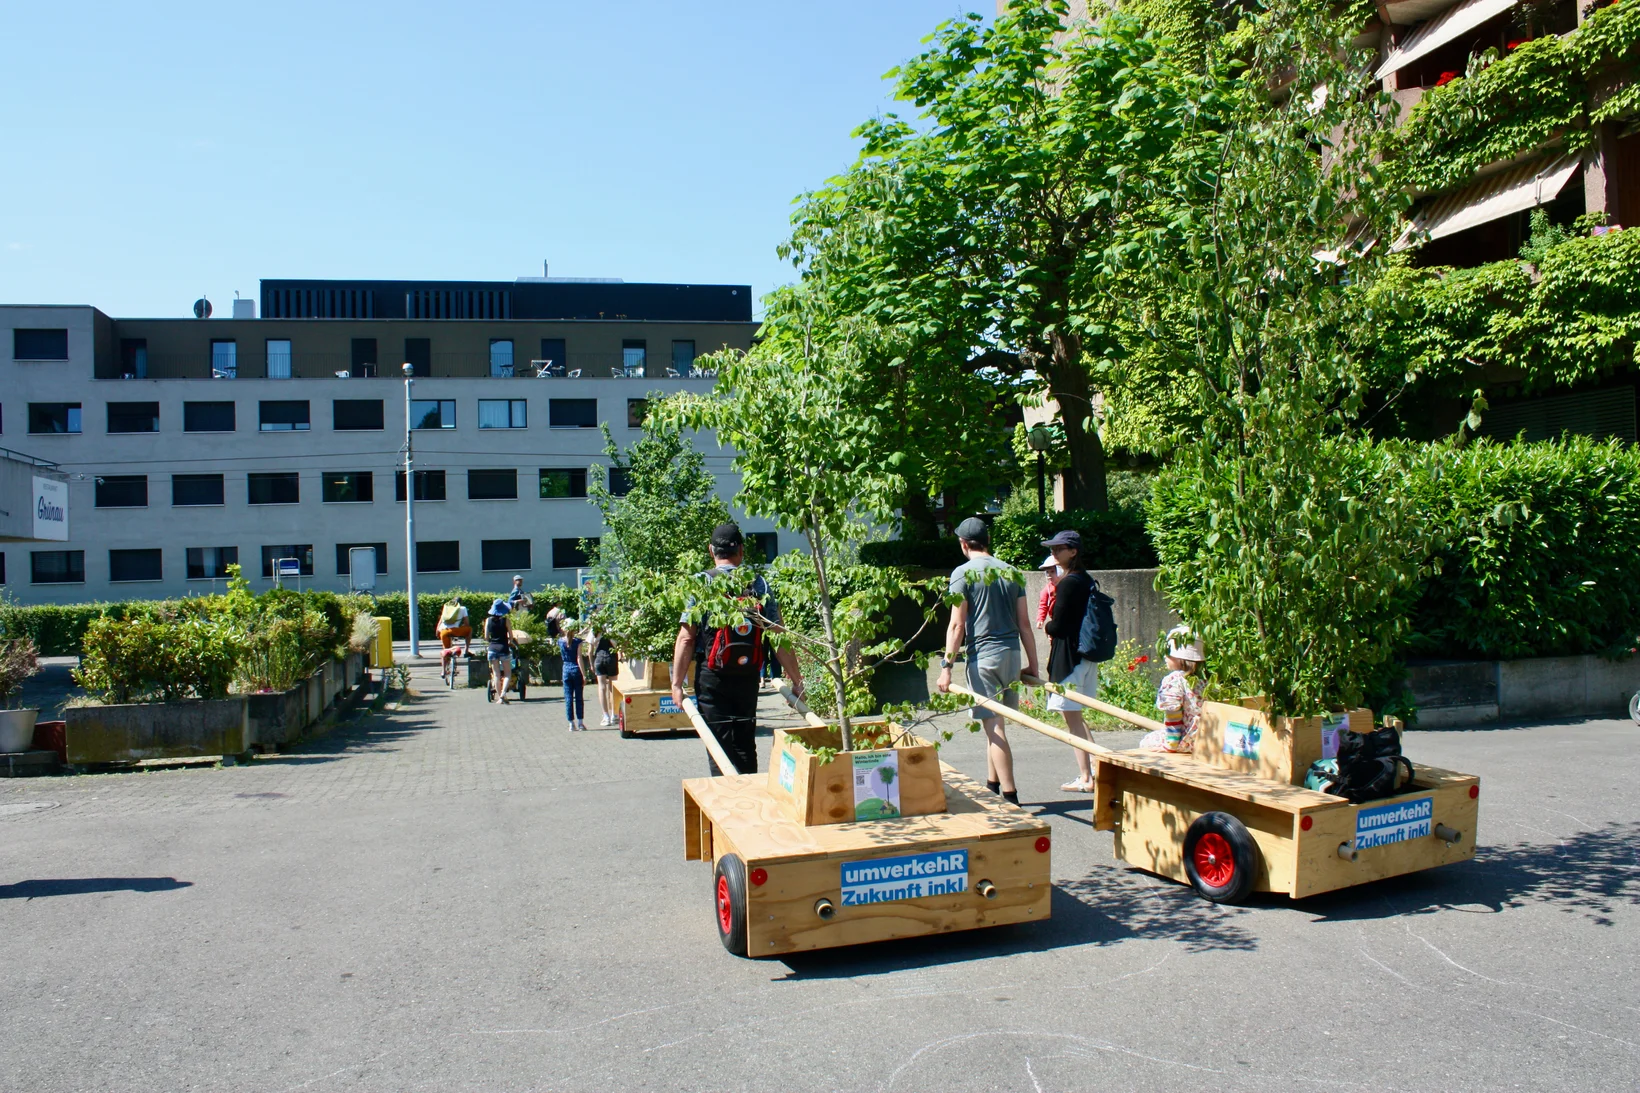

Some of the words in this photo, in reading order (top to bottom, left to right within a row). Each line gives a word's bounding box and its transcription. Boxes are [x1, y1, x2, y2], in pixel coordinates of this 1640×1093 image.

[38, 495, 64, 522] Grünau
[1359, 801, 1431, 829] umverkehR
[1356, 828, 1405, 850] Zukunft
[845, 854, 964, 883] umverkehR
[842, 883, 922, 906] Zukunft
